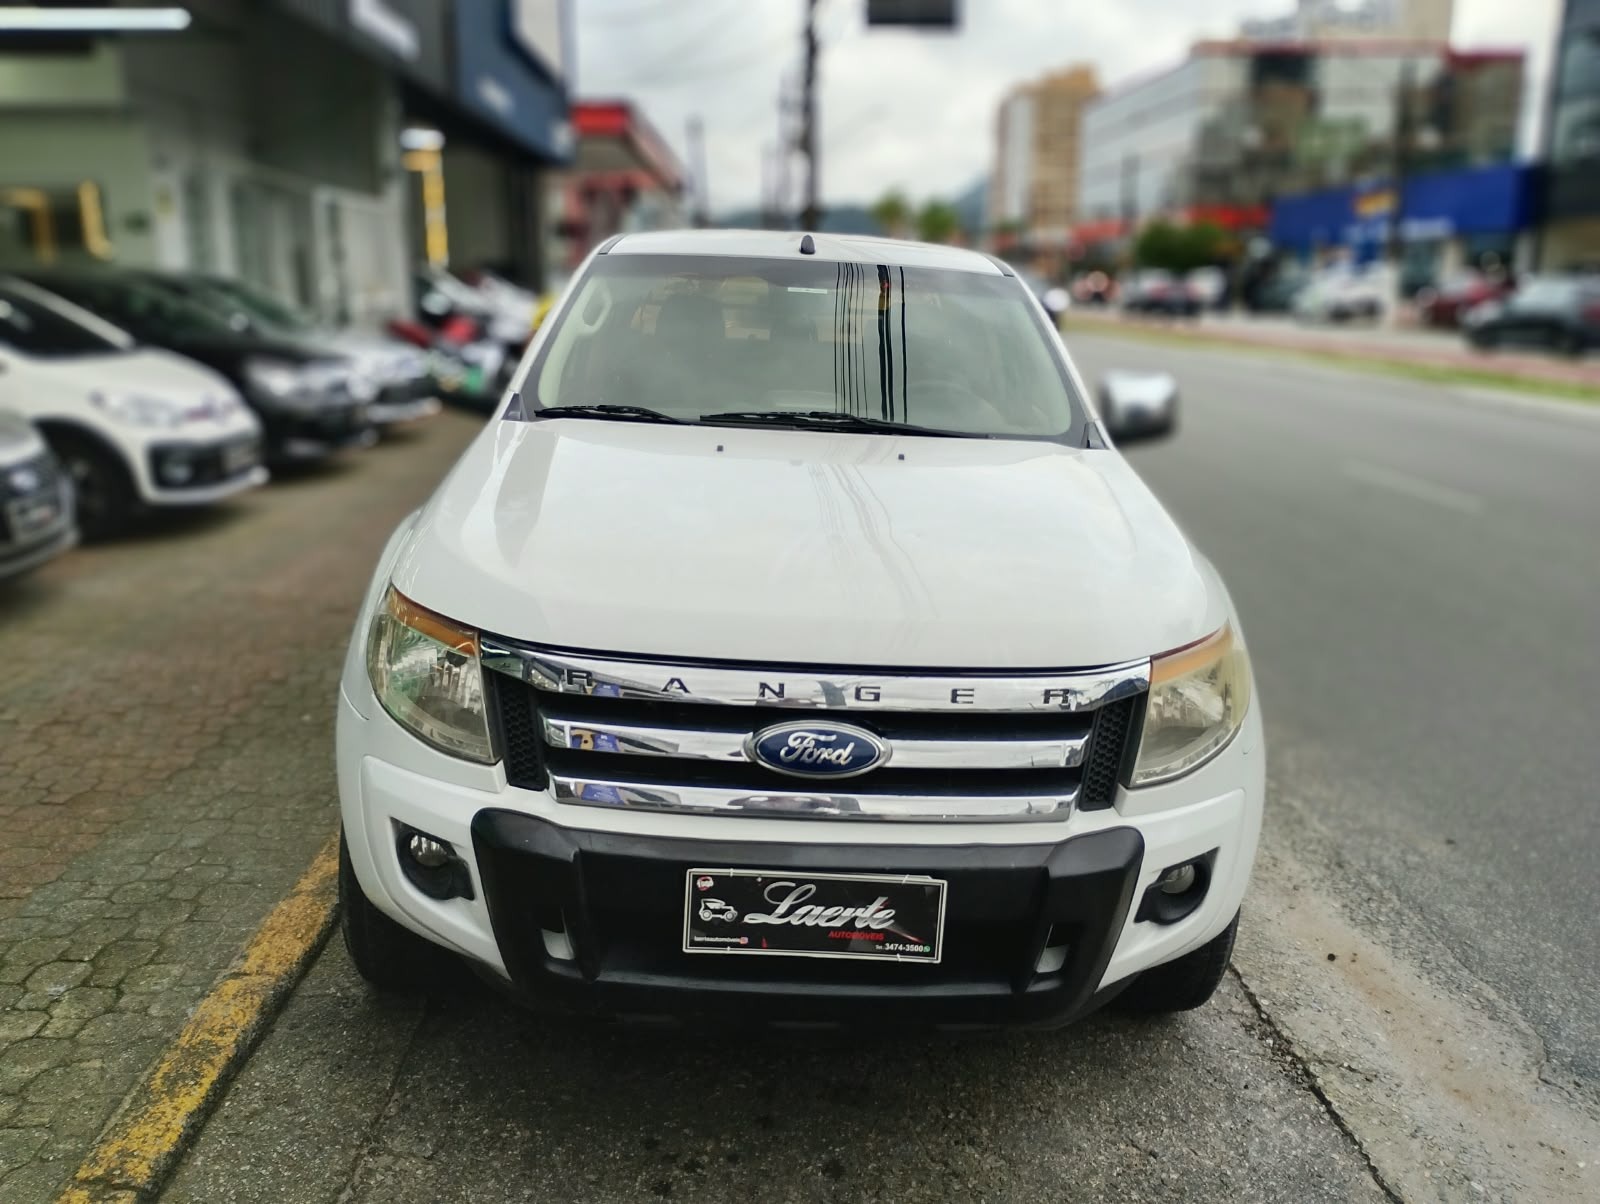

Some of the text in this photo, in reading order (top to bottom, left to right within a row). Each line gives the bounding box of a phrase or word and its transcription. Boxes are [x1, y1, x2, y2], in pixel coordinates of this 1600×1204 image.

[566, 669, 1071, 704] RANGER
[780, 731, 855, 765] Ford
[743, 881, 896, 929] Laerte
